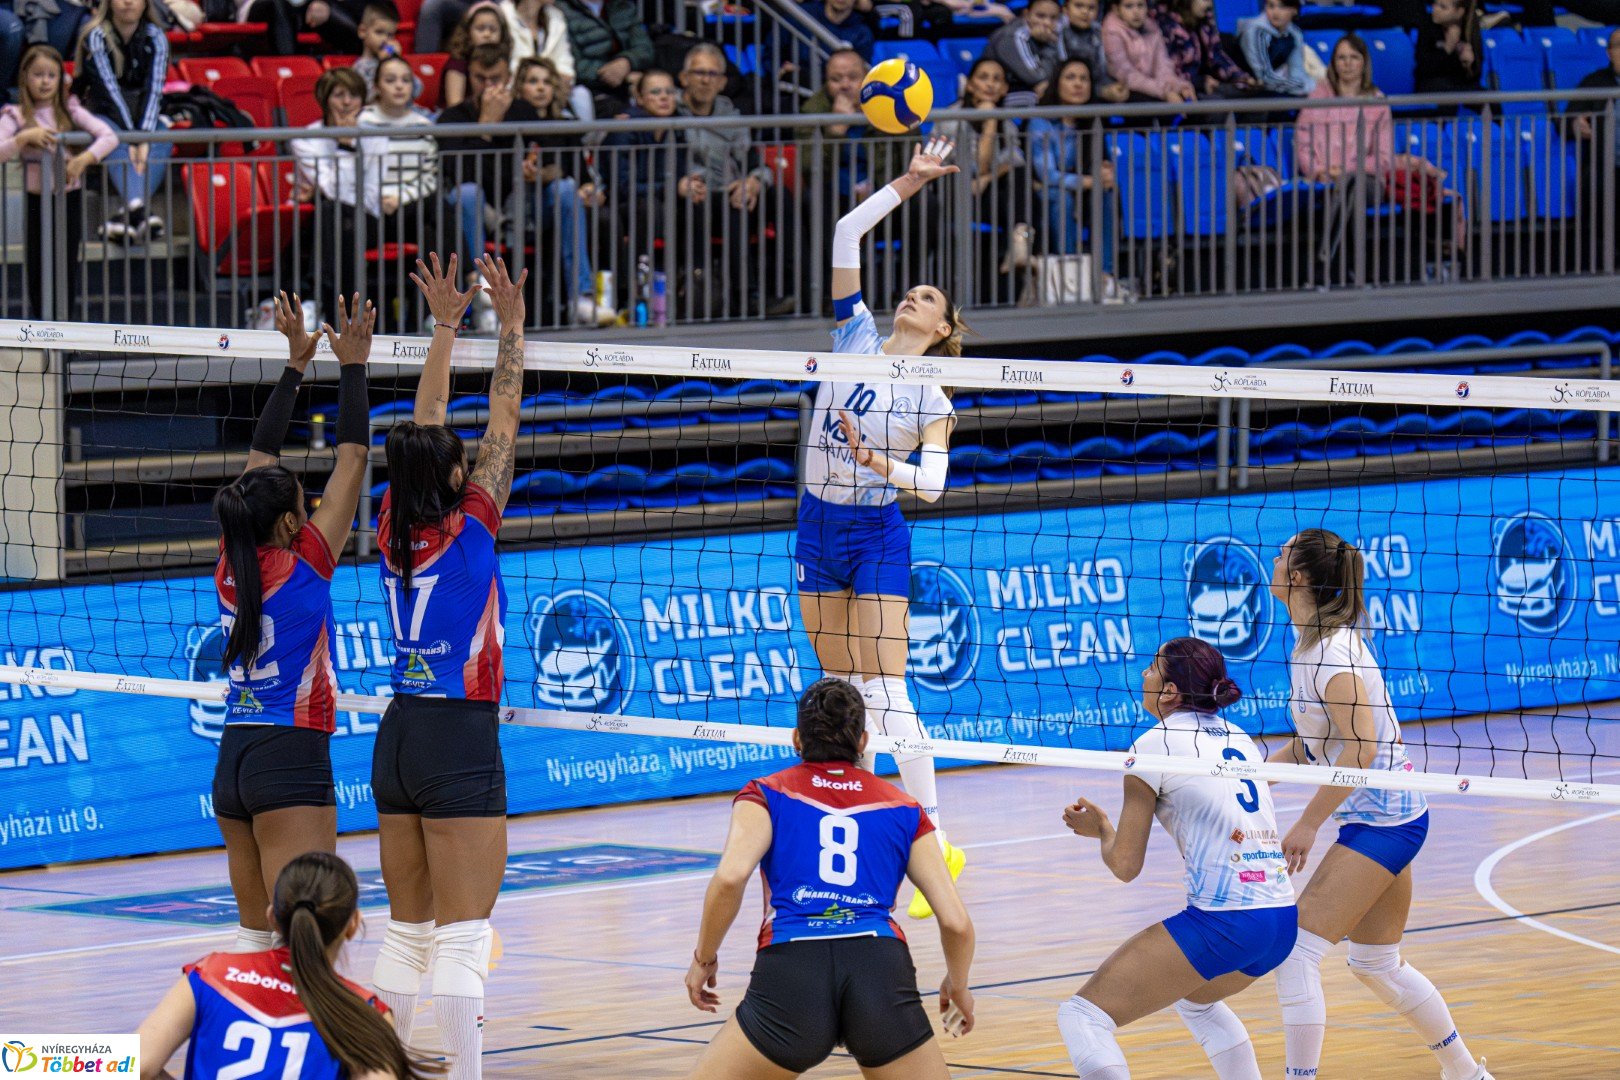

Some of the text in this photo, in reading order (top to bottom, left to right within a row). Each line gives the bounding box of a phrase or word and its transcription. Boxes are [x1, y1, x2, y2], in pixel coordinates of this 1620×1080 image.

[113, 329, 150, 347] FATUM
[691, 353, 731, 370] FATUM
[1001, 365, 1043, 383] FATUM
[843, 382, 877, 416] 10
[1330, 377, 1374, 396] FATUM
[986, 557, 1126, 612] MILKO
[384, 574, 439, 641] 17
[641, 586, 792, 643] MILKO
[997, 617, 1136, 673] CLEAN
[652, 647, 803, 705] CLEAN
[692, 725, 727, 739] FATUM
[1222, 747, 1260, 814] 3
[1331, 770, 1369, 785] FATUM
[58, 806, 81, 834] út
[83, 805, 104, 832] 9.
[818, 814, 860, 887] 8
[215, 1019, 311, 1080] 21
